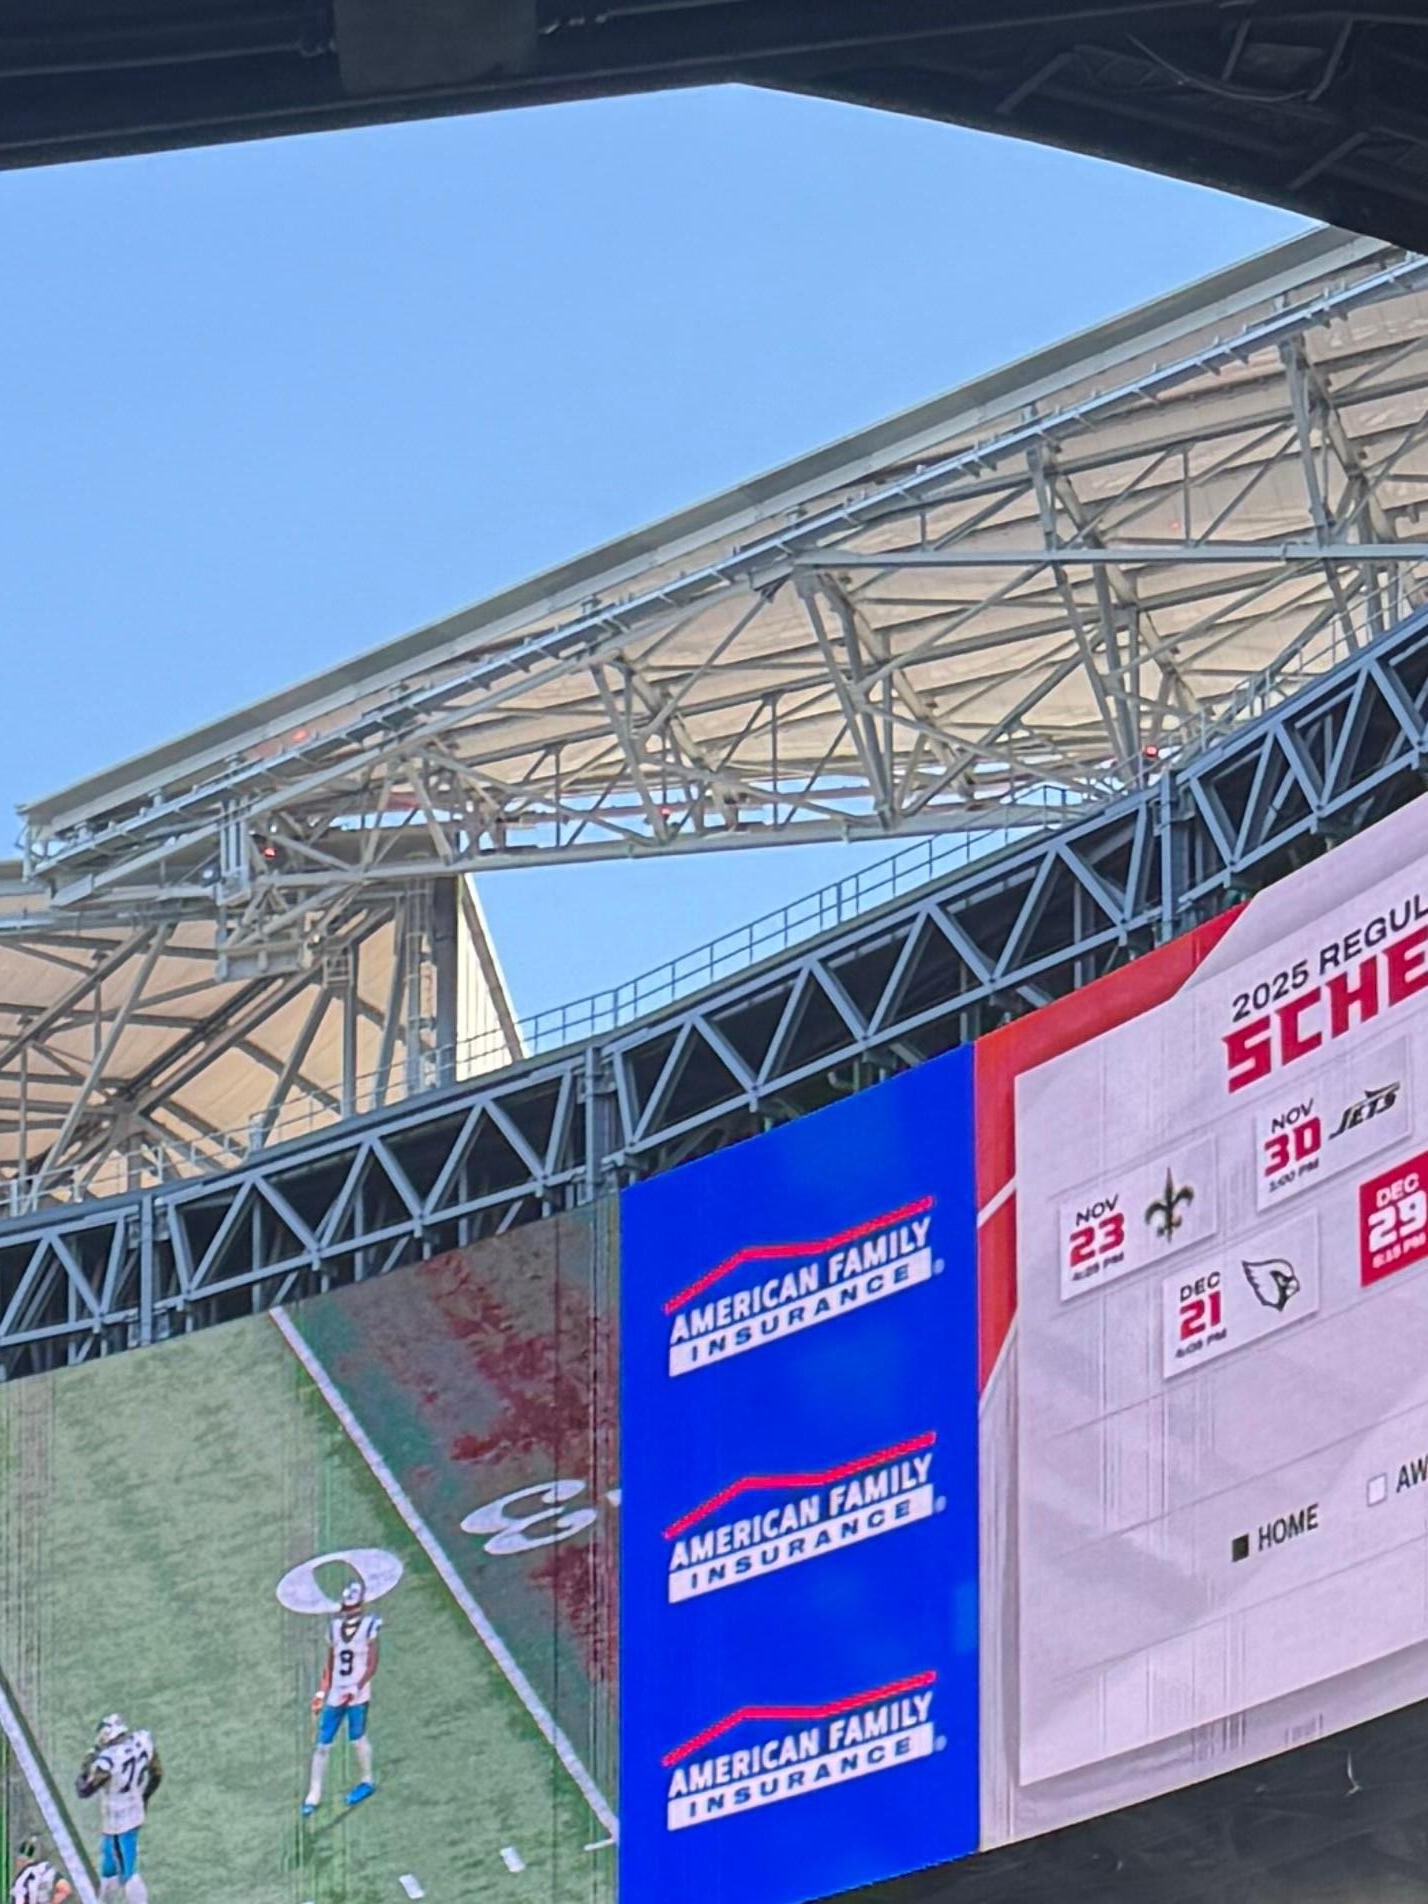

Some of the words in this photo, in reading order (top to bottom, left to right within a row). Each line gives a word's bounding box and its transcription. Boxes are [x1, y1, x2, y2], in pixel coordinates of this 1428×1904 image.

[1233, 960, 1309, 1022] 2025
[1328, 1081, 1401, 1140] JETS
[1264, 1116, 1321, 1177] 30
[1070, 1212, 1125, 1268] 23
[1369, 1191, 1428, 1253] 29
[671, 1266, 821, 1345] AMERICAN
[828, 1218, 931, 1291] FAMILY
[687, 1264, 913, 1363] INSURANCE
[1179, 1290, 1222, 1341] 21
[670, 1494, 821, 1571] AMERICAN
[830, 1455, 932, 1518] FAMILY
[1258, 1502, 1319, 1552] HOME
[688, 1503, 913, 1590] INSURANCE
[670, 1730, 821, 1798] AMERICAN
[830, 1692, 932, 1752] FAMILY
[688, 1736, 913, 1820] INSURANCE
